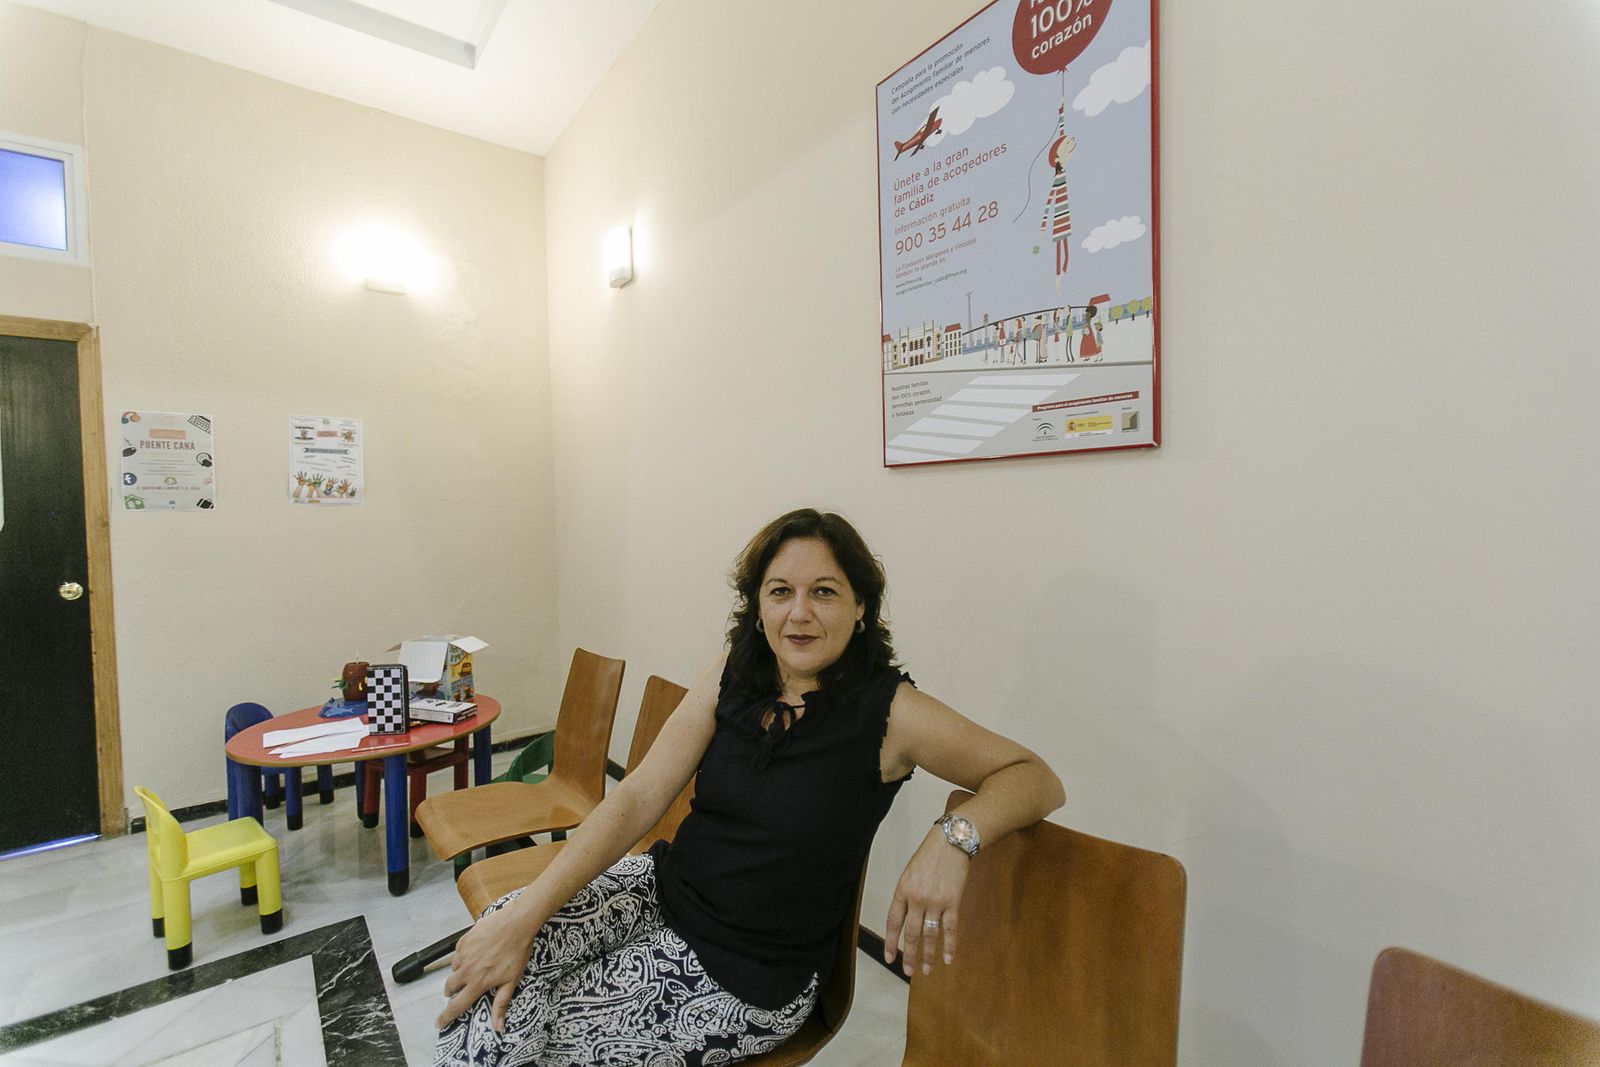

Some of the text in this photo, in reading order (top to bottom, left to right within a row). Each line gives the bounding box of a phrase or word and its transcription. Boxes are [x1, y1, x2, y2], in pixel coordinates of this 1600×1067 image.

[955, 54, 963, 63] de
[964, 37, 990, 57] menores
[1031, 14, 1092, 59] corazón
[891, 43, 963, 94] Campaña para la promoción
[891, 66, 965, 115] con necesidades especiales
[894, 147, 969, 191] Únete a la gran
[894, 143, 1008, 205] familia de acogedores
[895, 193, 935, 218] de Cádiz
[895, 197, 971, 235] Información gratuita
[896, 201, 999, 255] 900 35 44 28
[140, 440, 171, 450] PUENTE
